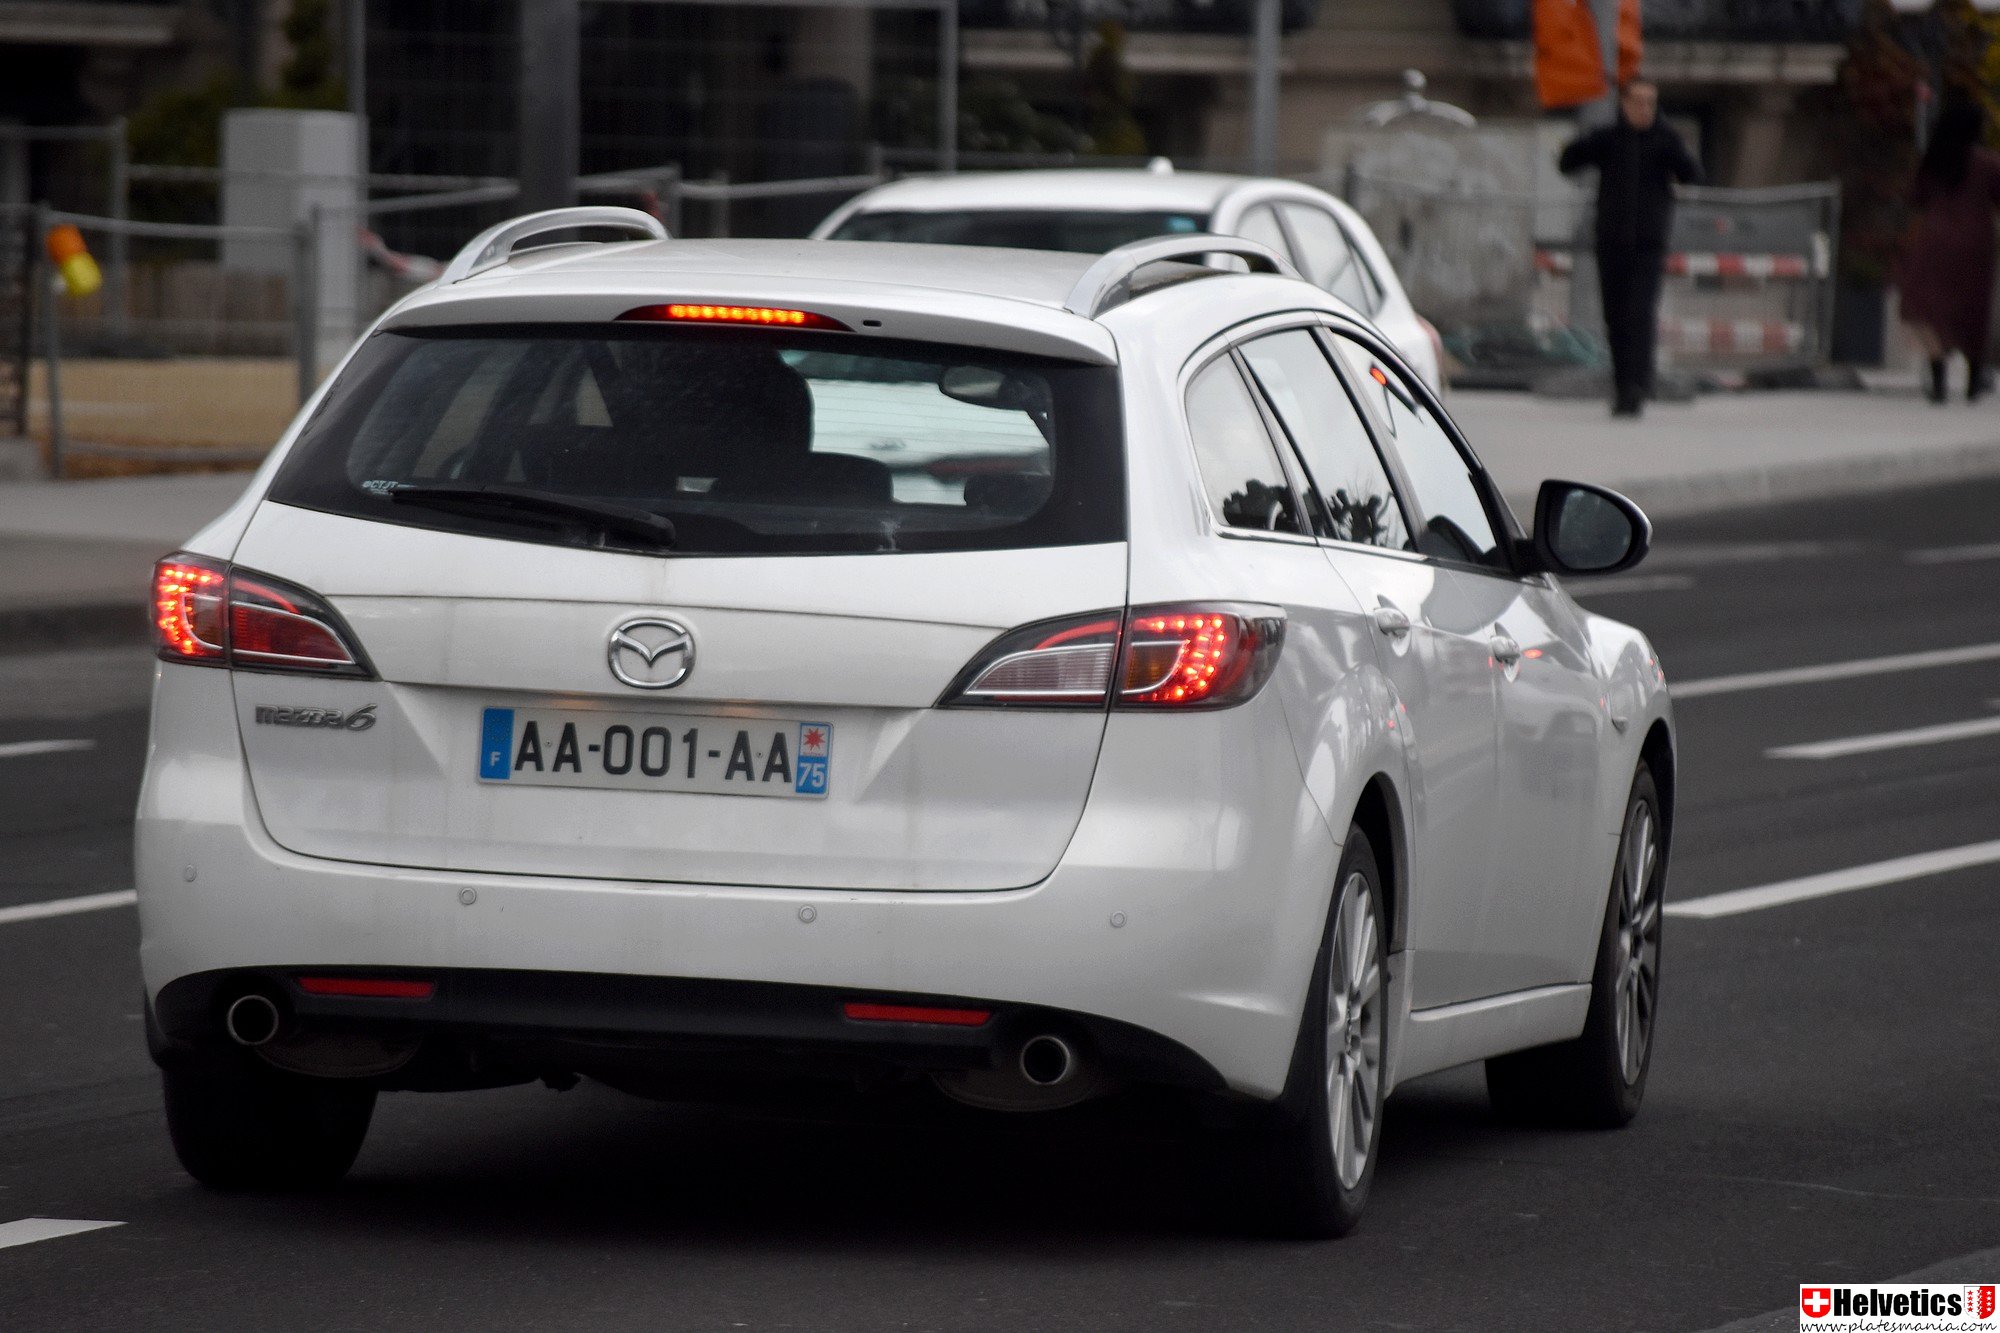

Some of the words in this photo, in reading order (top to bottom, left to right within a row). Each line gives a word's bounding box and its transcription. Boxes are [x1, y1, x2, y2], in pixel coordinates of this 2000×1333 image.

[490, 751, 501, 767] F
[514, 720, 793, 783] AA-001-AA
[799, 762, 825, 788] 75
